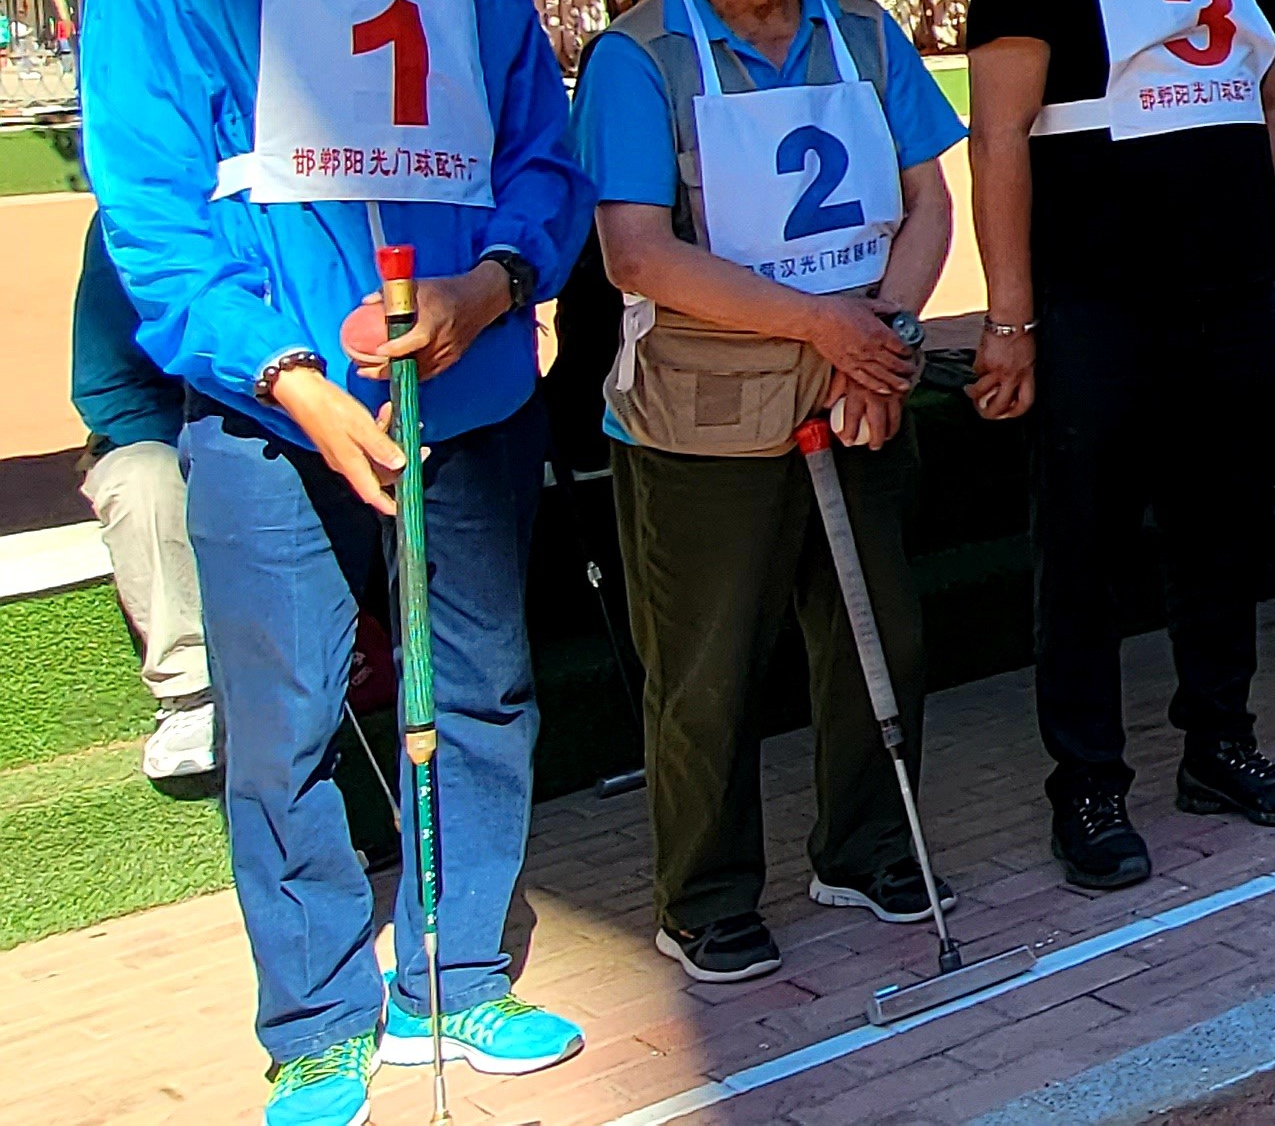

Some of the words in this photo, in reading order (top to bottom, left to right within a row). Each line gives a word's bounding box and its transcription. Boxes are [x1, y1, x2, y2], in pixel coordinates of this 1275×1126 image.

[292, 147, 479, 181] 邯郸阳光门球配件厂
[776, 124, 865, 242] 2
